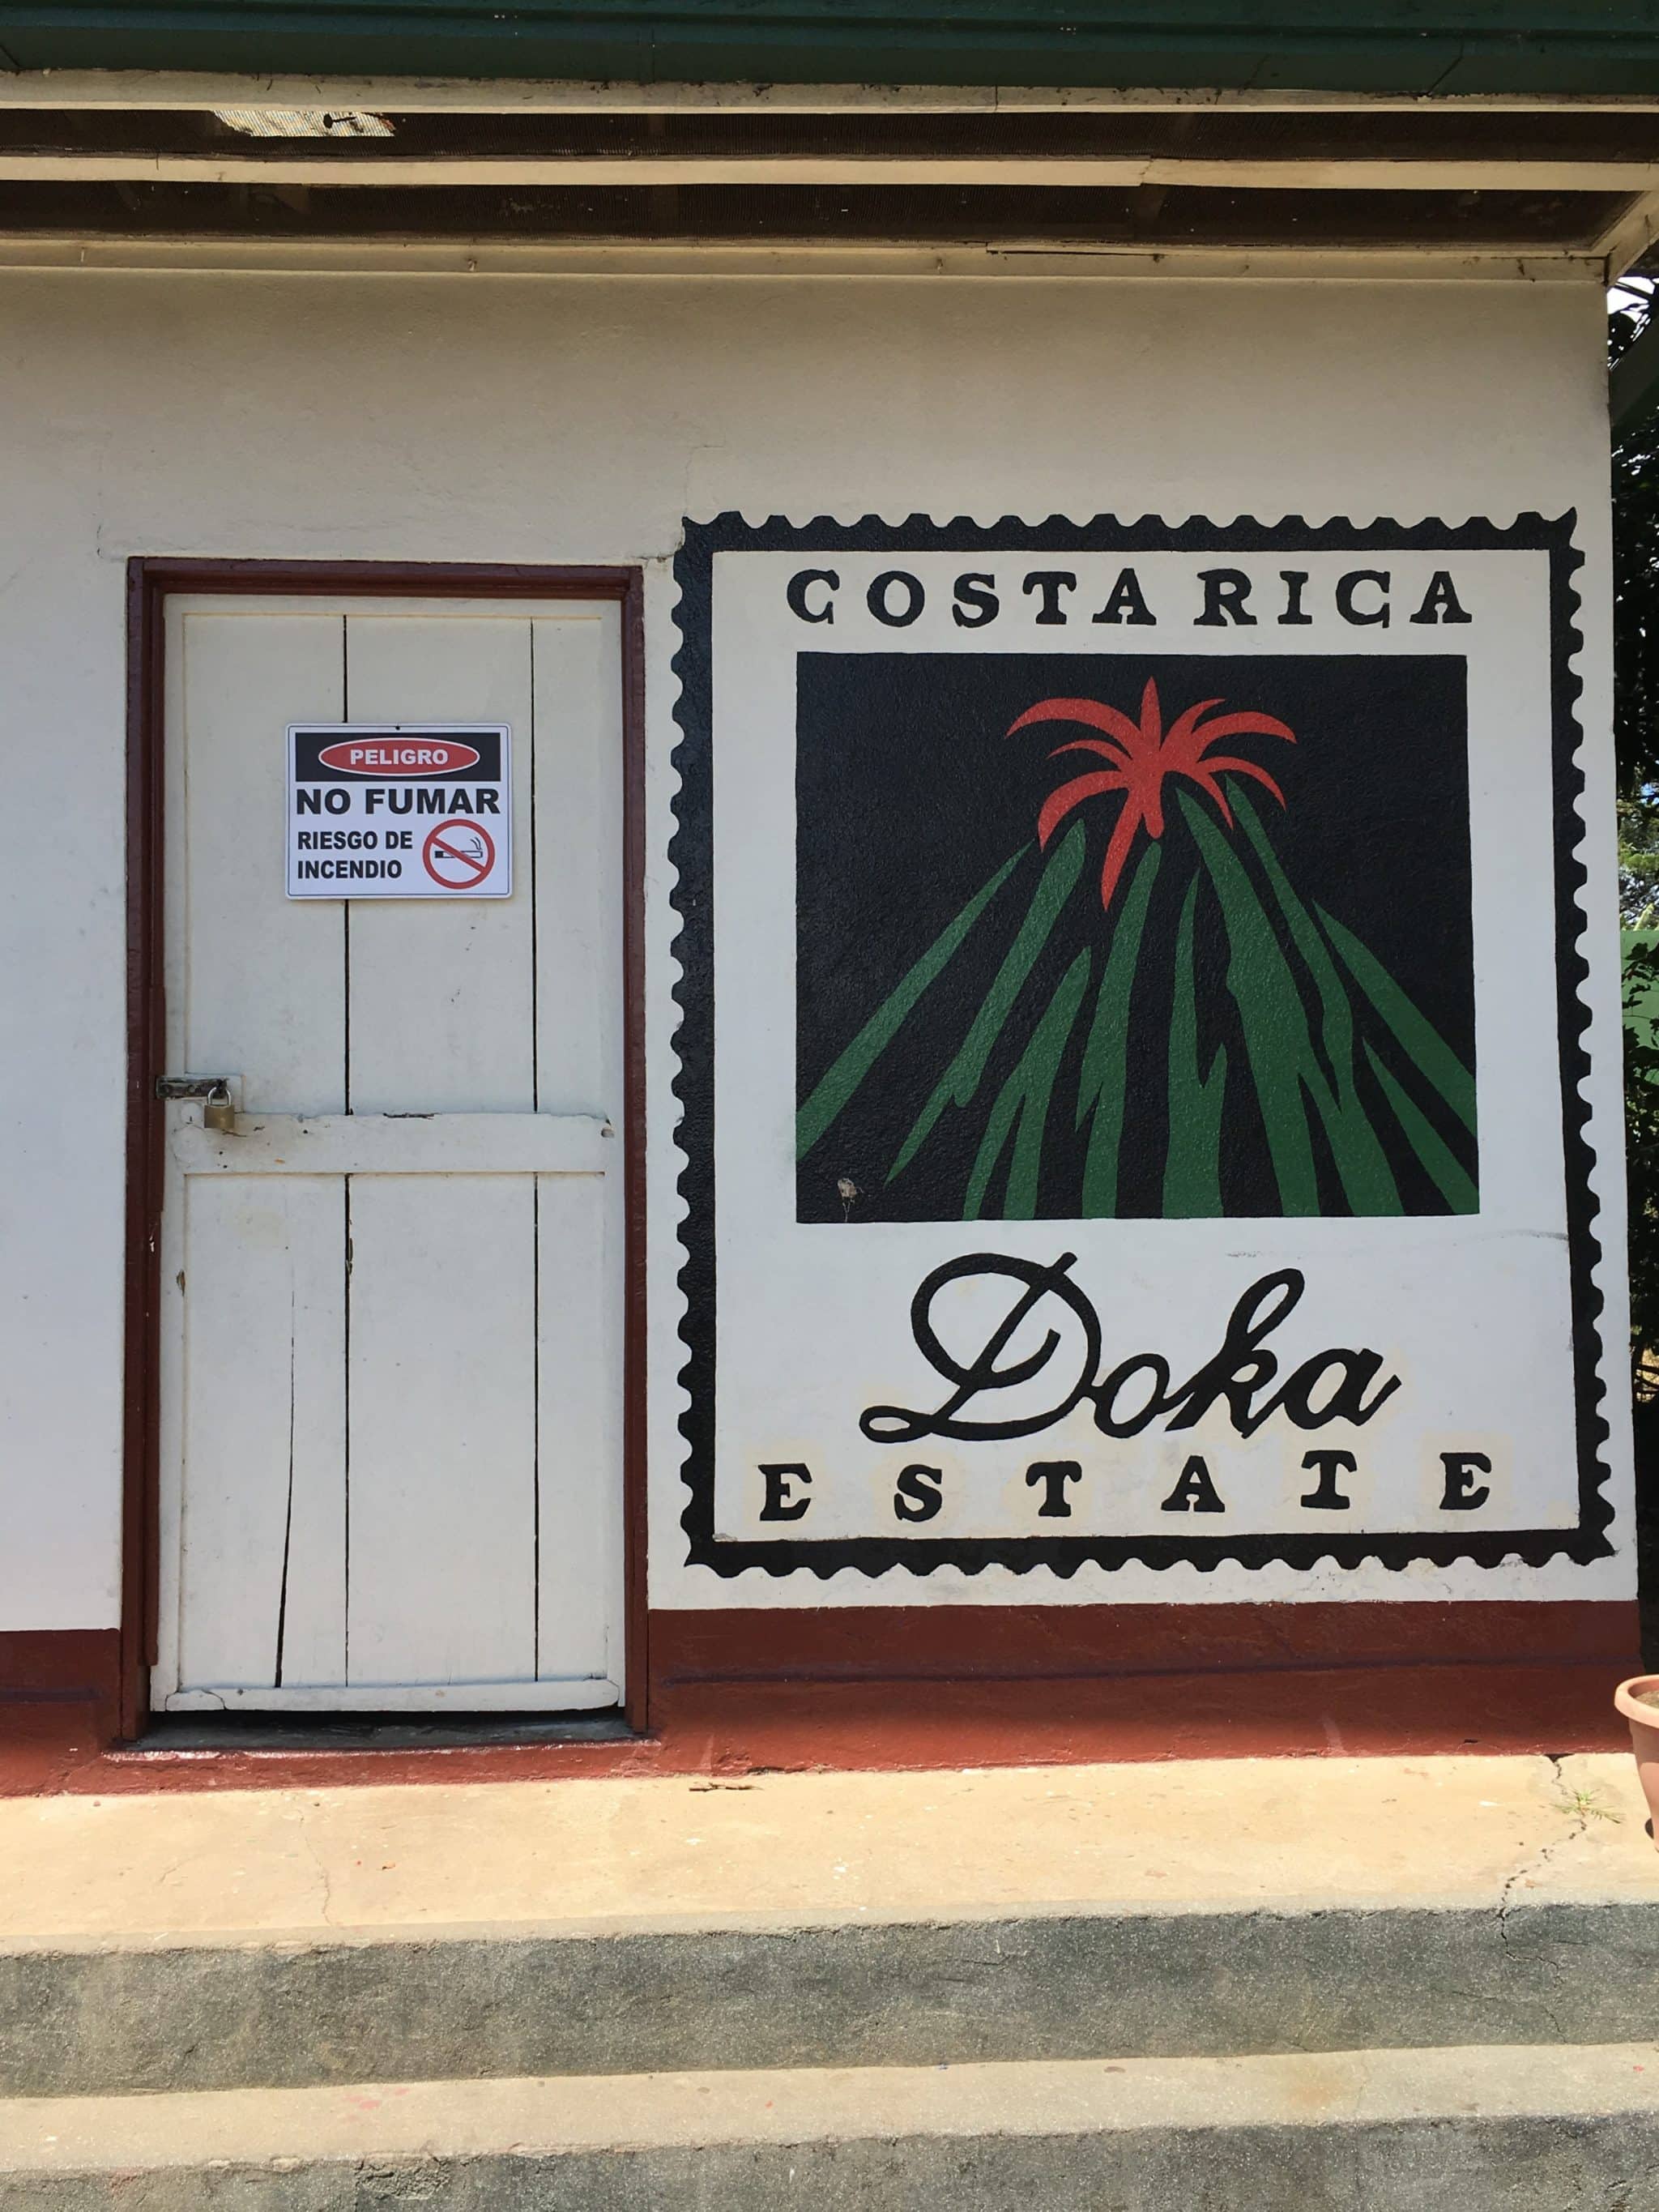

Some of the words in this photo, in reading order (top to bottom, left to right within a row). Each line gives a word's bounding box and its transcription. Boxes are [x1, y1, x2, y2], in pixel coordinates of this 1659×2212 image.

[787, 568, 1157, 629] COSTA
[1194, 569, 1473, 629] RICA
[350, 749, 449, 765] PELIGRO
[296, 788, 351, 814] NO
[365, 788, 501, 814] FUMAR
[298, 831, 378, 849] RIESGO
[386, 831, 413, 849] DE
[298, 860, 402, 879] INCENDIO
[859, 1253, 1402, 1444] Doka
[757, 1450, 1492, 1523] ESTATE
